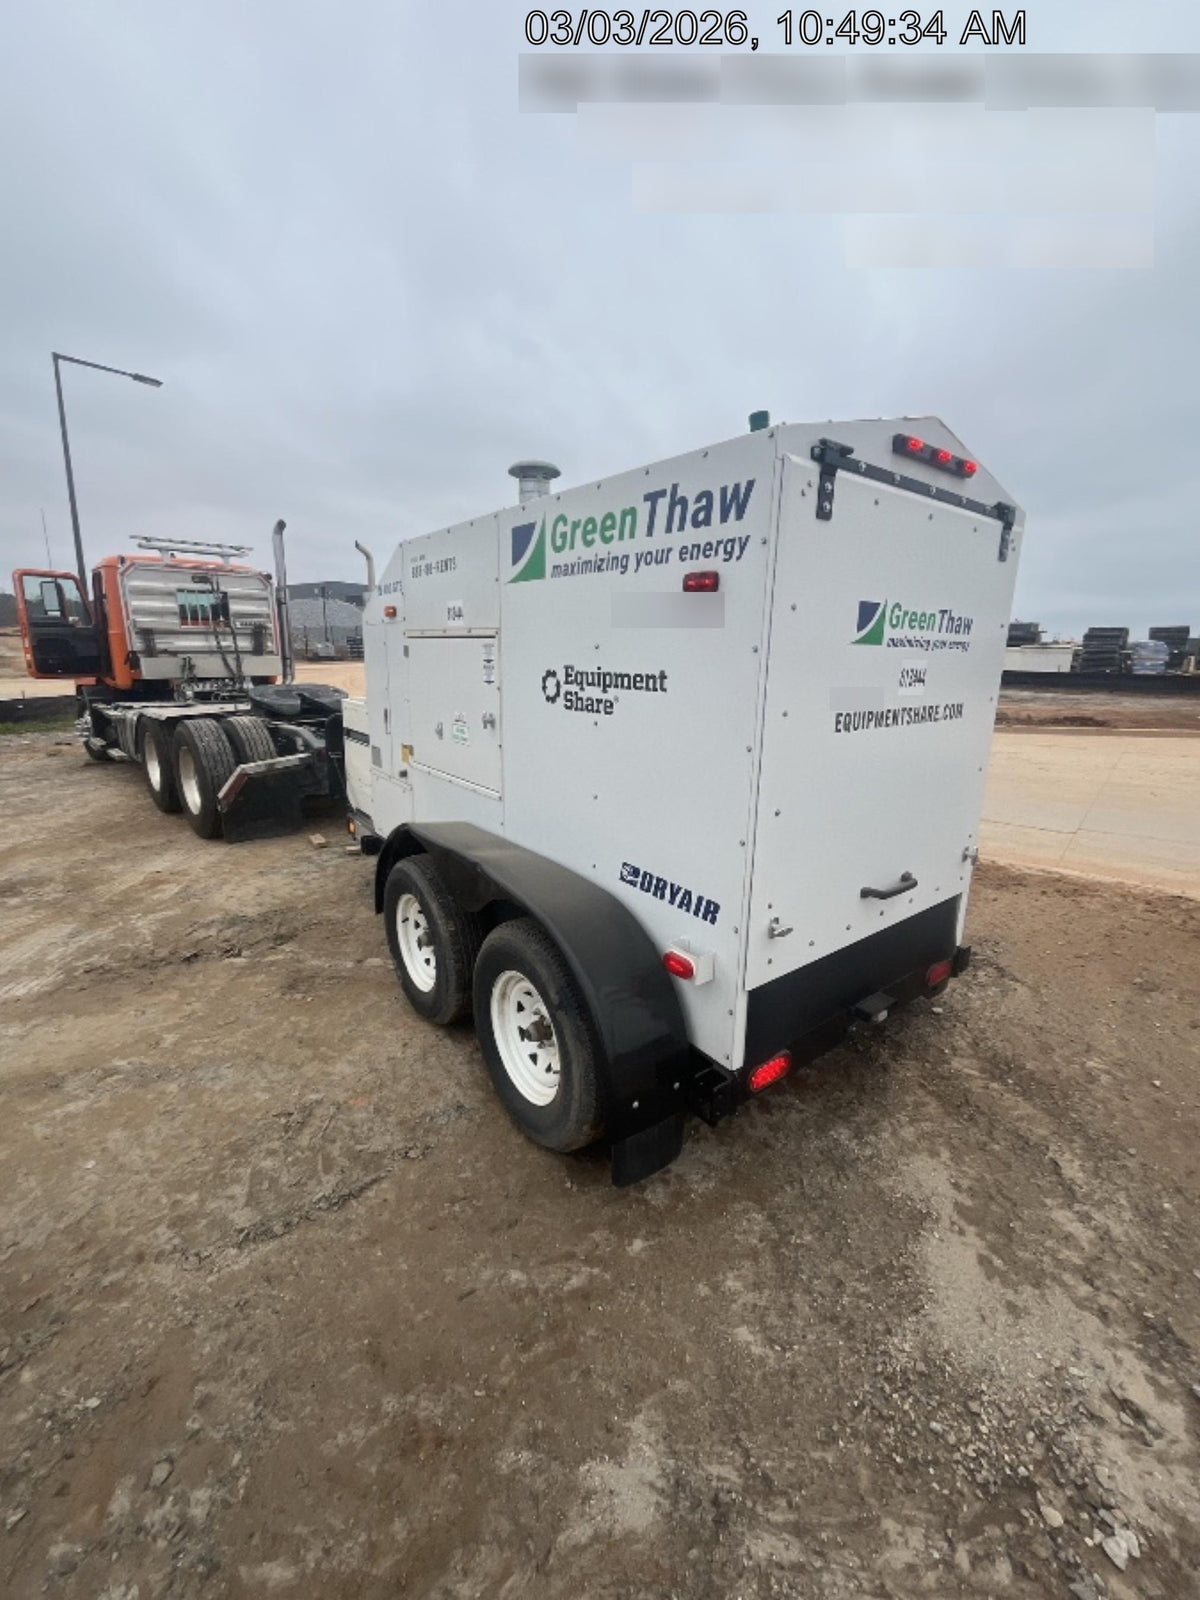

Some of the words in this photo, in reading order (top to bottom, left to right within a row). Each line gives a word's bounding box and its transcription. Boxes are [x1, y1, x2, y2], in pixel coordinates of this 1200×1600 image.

[551, 551, 629, 579] maximizing
[634, 547, 673, 573] your
[679, 534, 750, 563] energy
[563, 665, 668, 694] Equipment
[563, 691, 614, 715] Share
[835, 702, 964, 733] EQUIPMENTSHARE.COM
